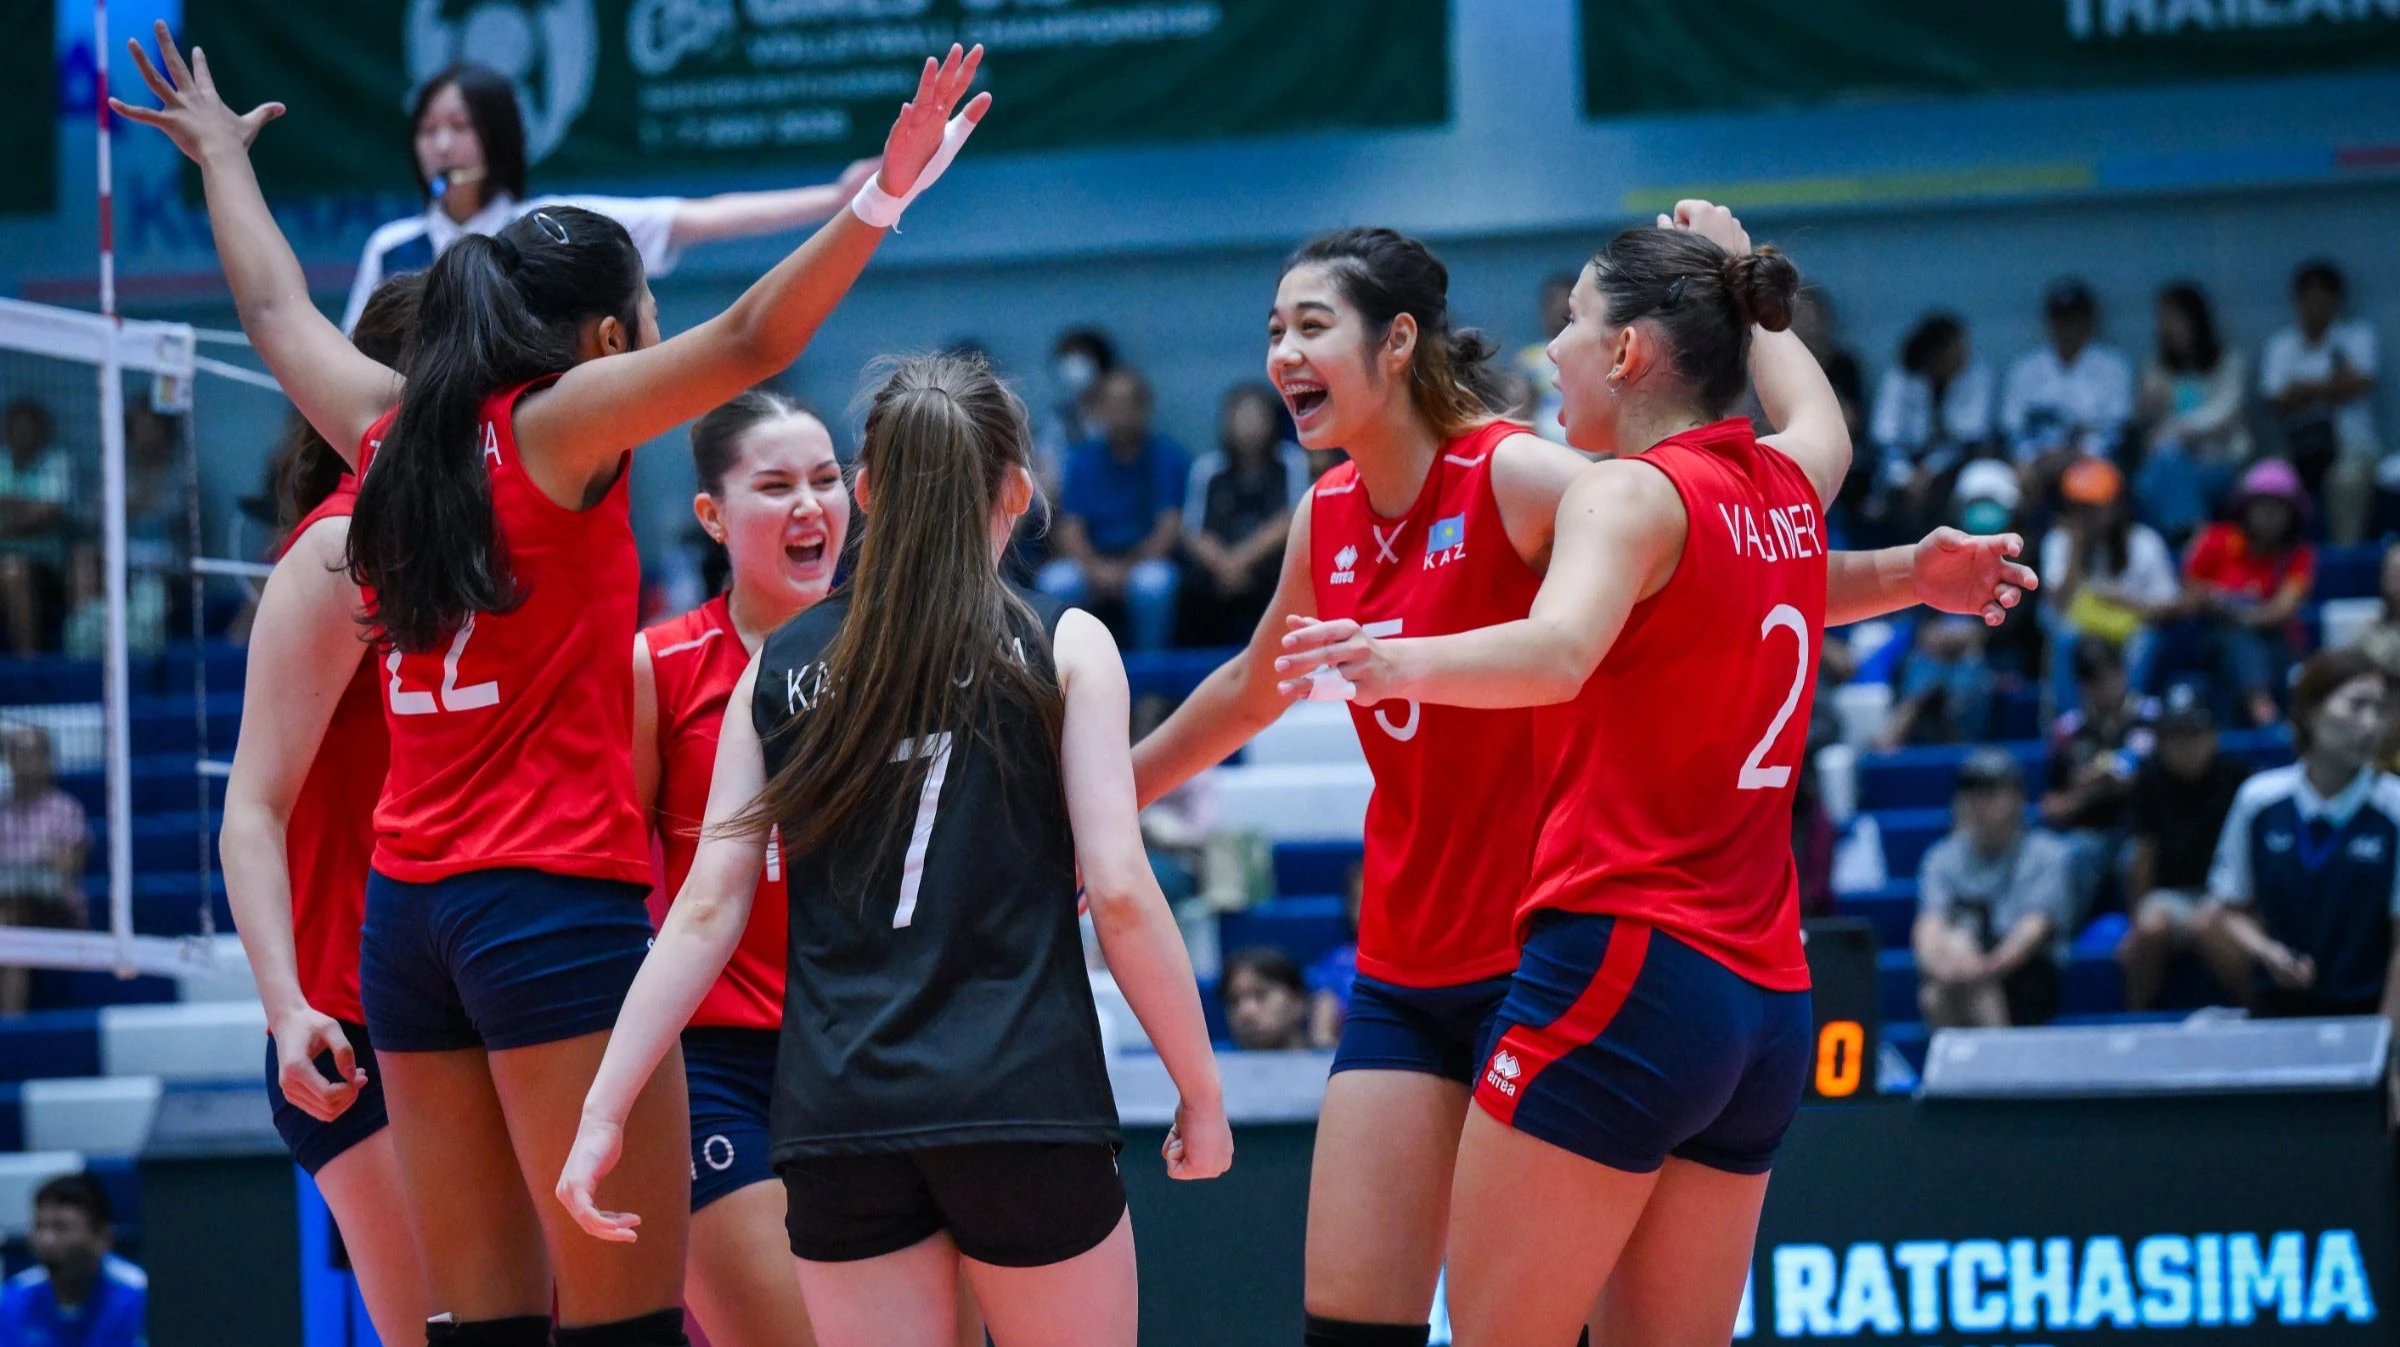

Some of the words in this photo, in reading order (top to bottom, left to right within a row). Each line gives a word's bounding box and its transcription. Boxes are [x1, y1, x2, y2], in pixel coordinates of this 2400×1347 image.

[1423, 542, 1466, 571] KAZ
[1737, 604, 1809, 789] 2
[890, 731, 952, 929] 7
[1815, 1021, 1865, 1097] 0
[1774, 1230, 2376, 1337] RATCHASIMA
